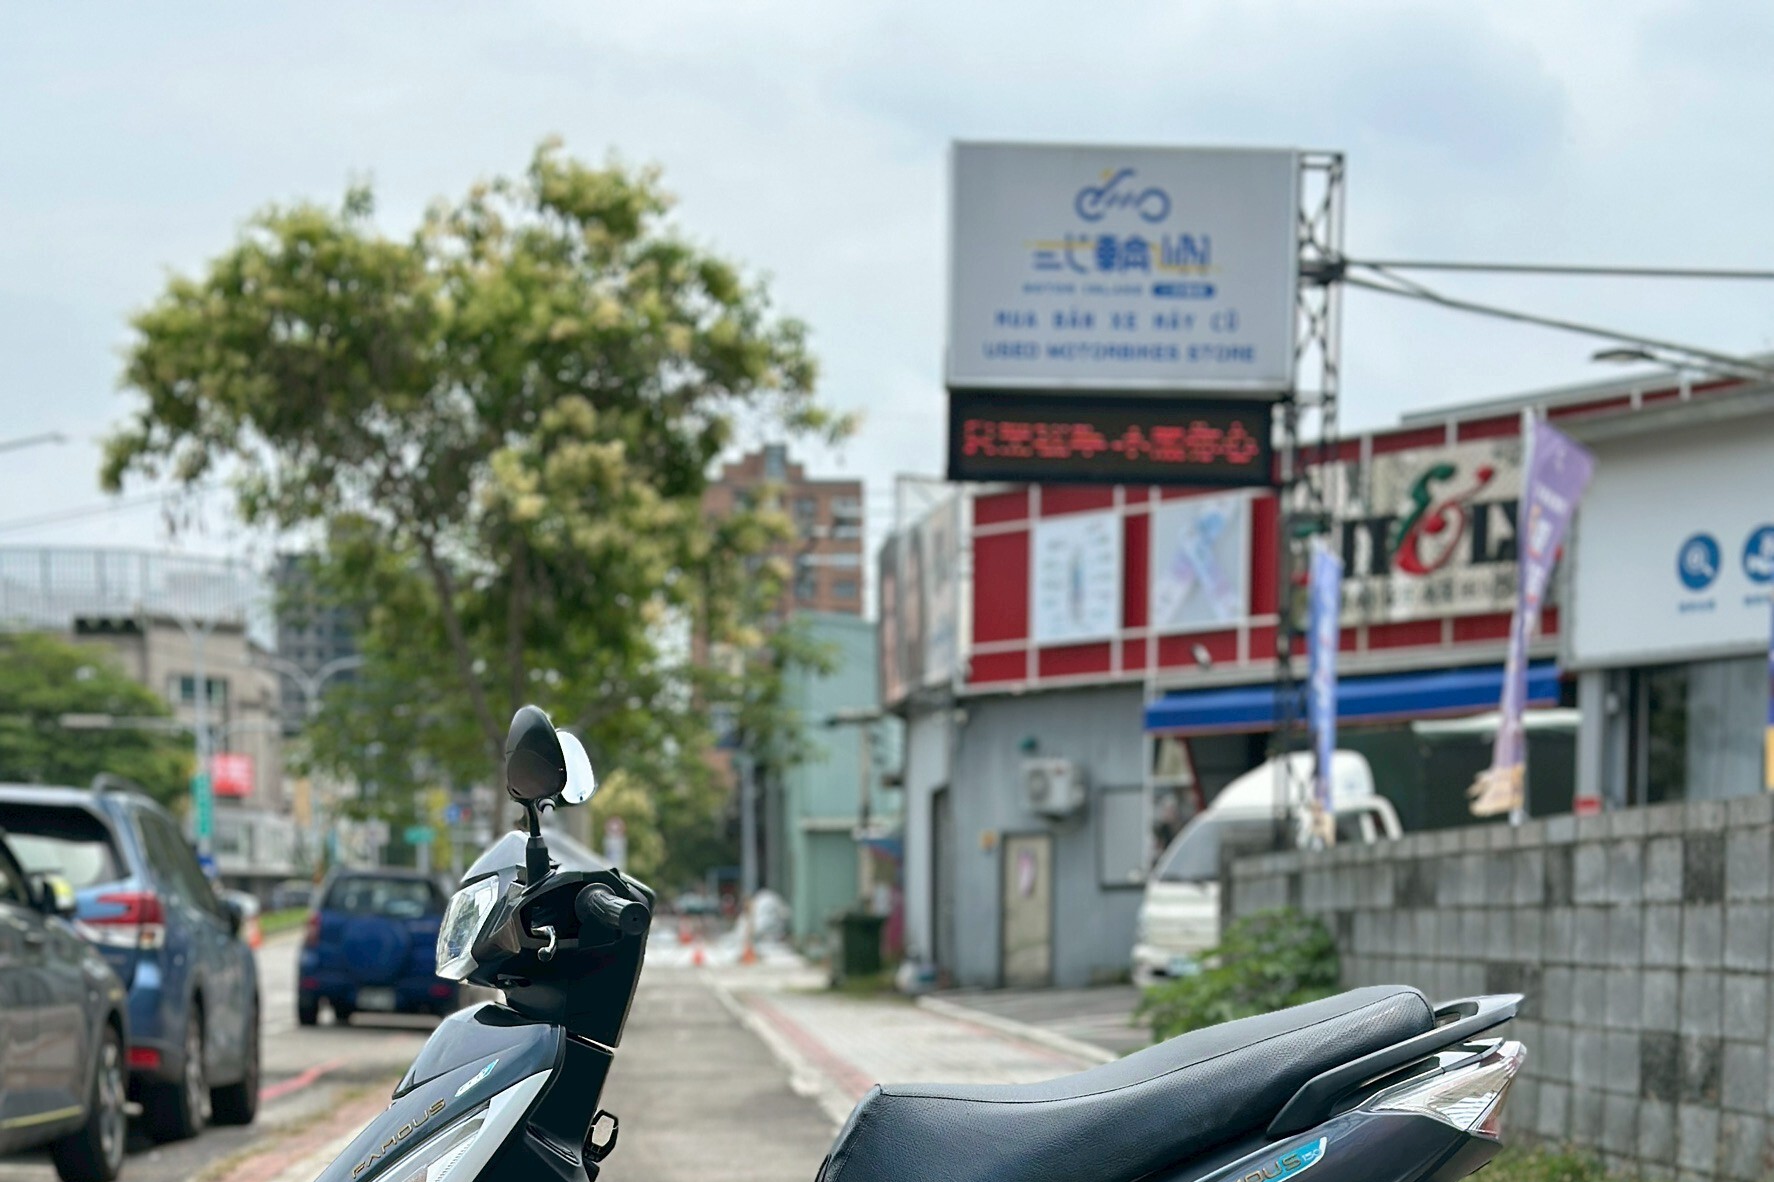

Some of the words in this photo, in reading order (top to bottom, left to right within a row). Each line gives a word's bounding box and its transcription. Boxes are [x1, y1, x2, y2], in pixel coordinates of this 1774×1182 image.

[995, 309, 1038, 329] MUA
[1109, 310, 1139, 331] XE
[983, 340, 1040, 361] USED
[1046, 341, 1180, 362] MOTORBIKES
[1186, 343, 1257, 364] STORE
[353, 1098, 446, 1179] FAMOUS
